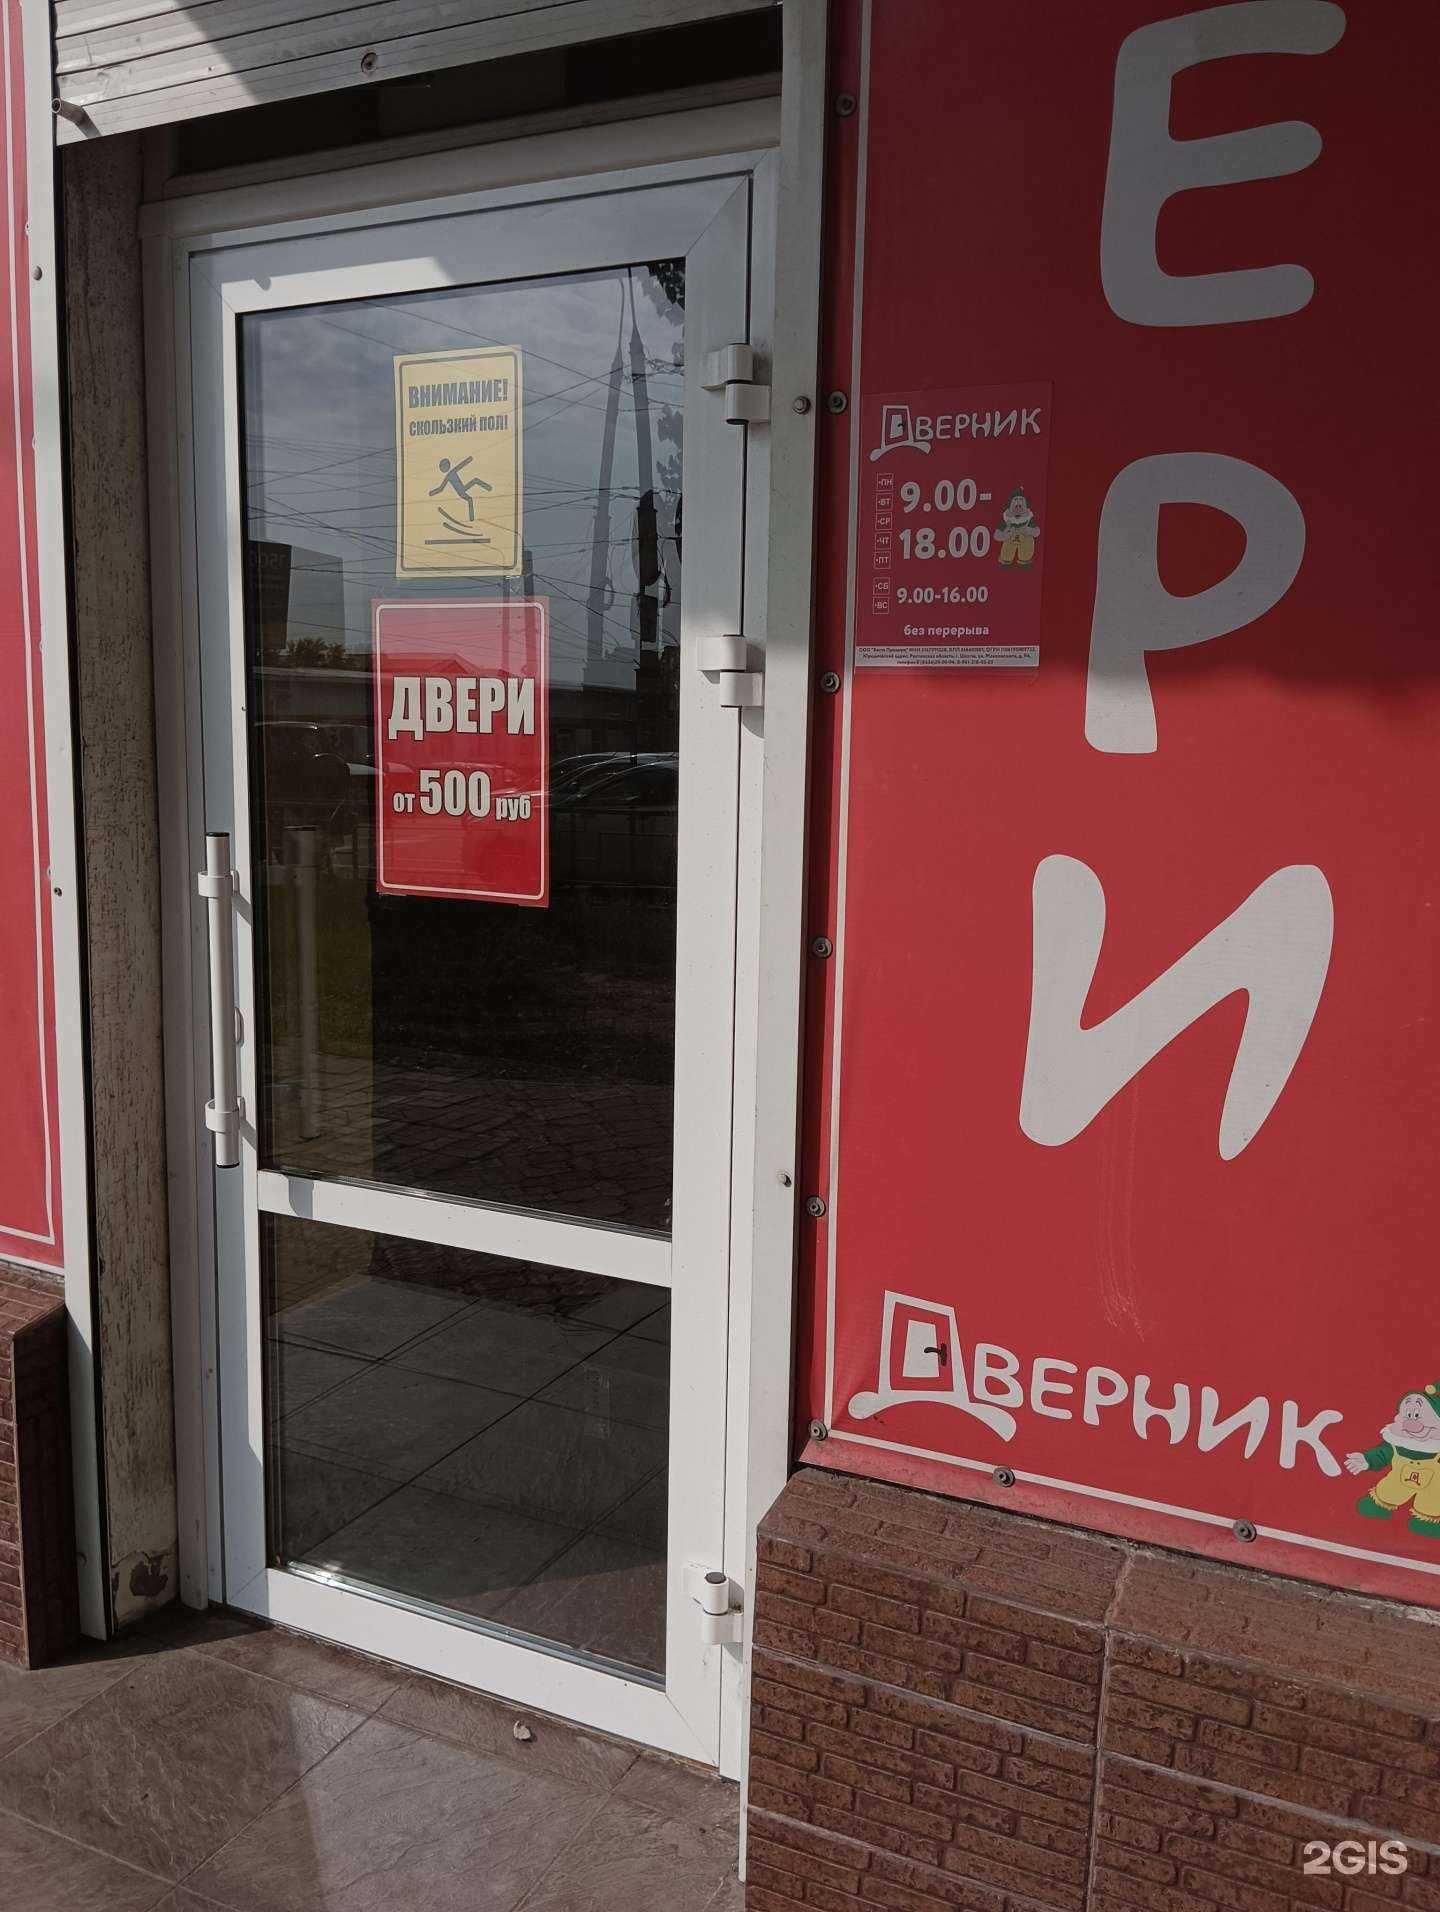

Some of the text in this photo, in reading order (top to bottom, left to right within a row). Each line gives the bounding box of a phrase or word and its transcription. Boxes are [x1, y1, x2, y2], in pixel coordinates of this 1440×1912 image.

[408, 378, 508, 409] ВНИМАНИЕ!
[409, 414, 508, 436] СКОЛЬЗКИЙ ПОЛ!
[869, 404, 1042, 462] ДВЕРНИК
[900, 478, 992, 513] 9.00-
[899, 525, 990, 560] 18.00
[896, 586, 989, 604] 9.00-16.00
[904, 624, 990, 638] без перерыва
[388, 676, 535, 741] ДВЕРИ
[393, 769, 531, 821] от 500 руб
[848, 1289, 1344, 1477] ДВЕРНИК
